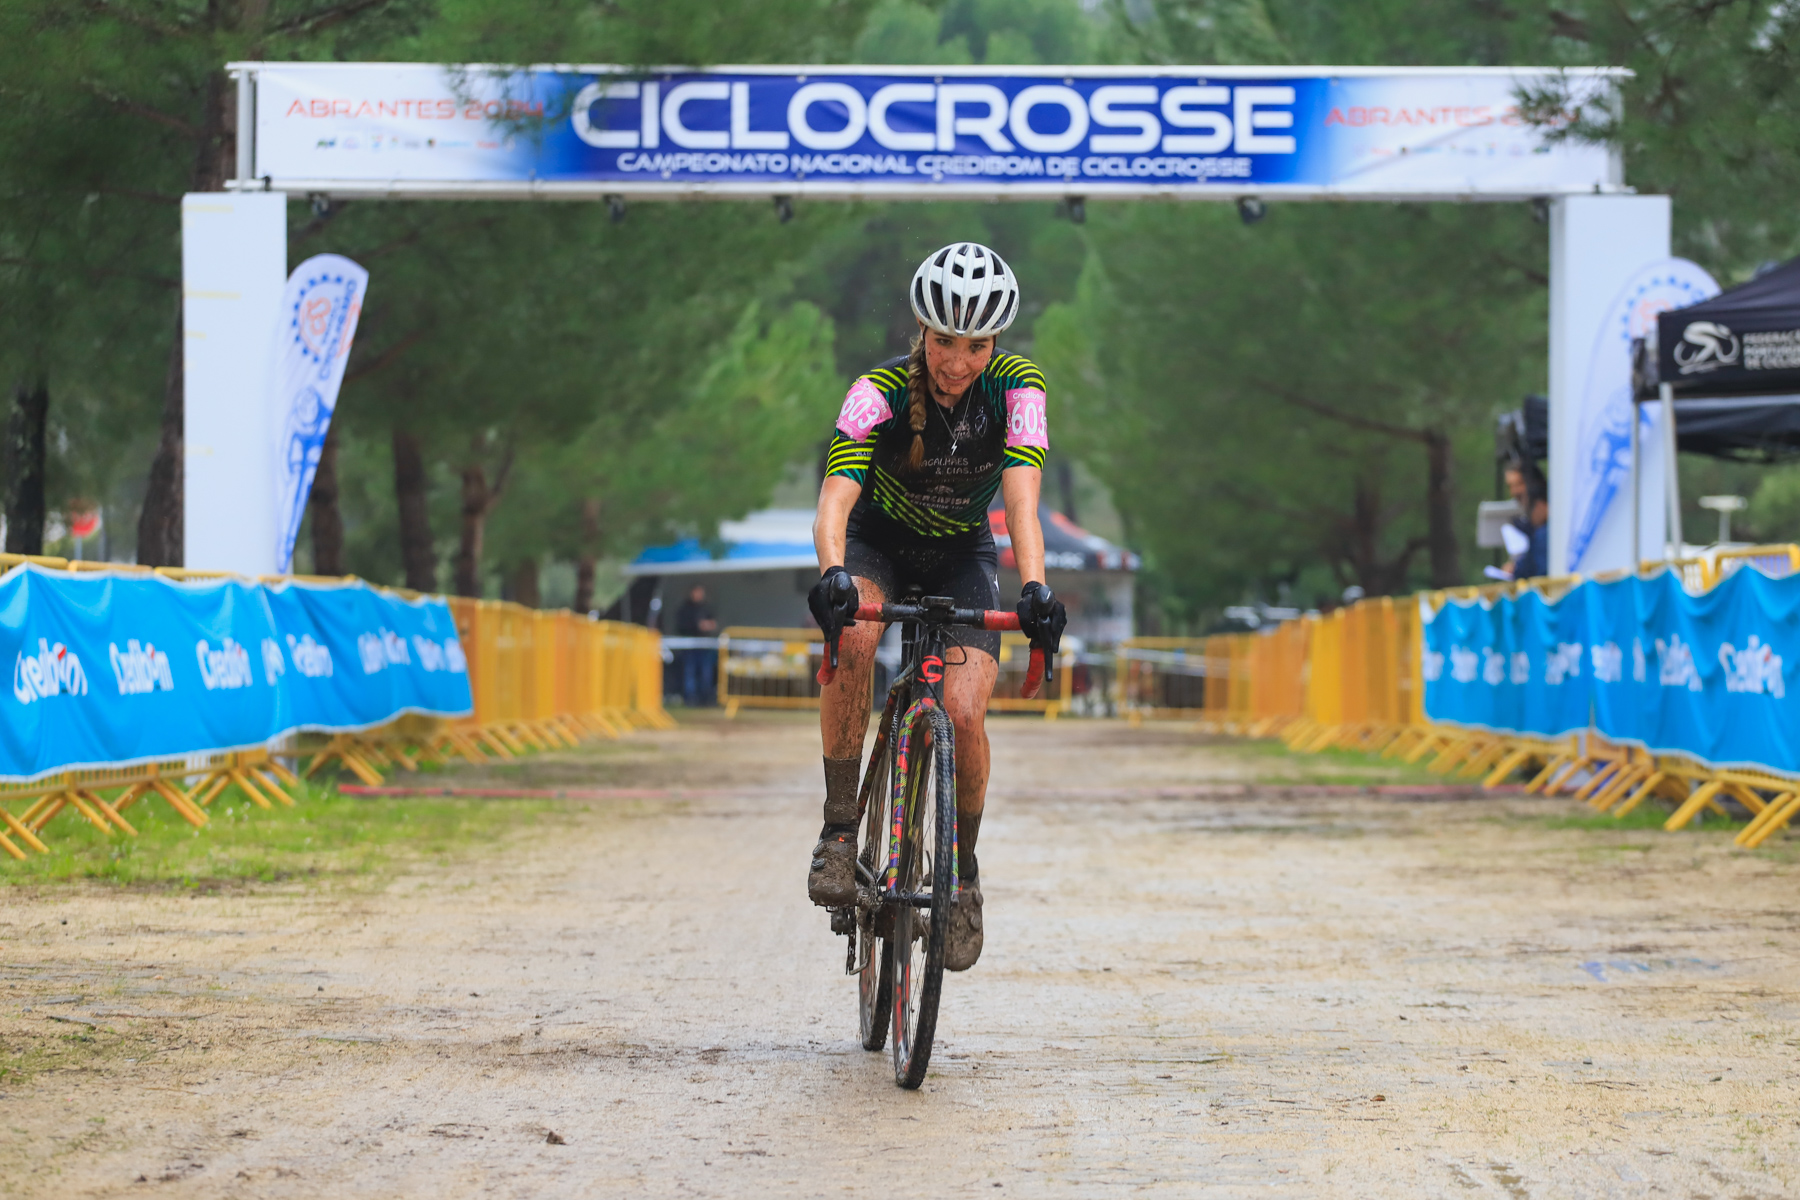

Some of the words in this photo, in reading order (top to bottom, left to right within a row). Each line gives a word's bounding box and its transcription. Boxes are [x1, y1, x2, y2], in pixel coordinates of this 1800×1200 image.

[286, 99, 457, 119] ABRANTES
[571, 81, 1296, 154] CICLOCROSSE
[1324, 106, 1494, 127] ABRANTES
[617, 152, 789, 172] CAMPEONATO
[790, 154, 915, 174] NACIONAL
[916, 155, 1044, 175] CREDIBOM
[1046, 157, 1080, 176] DE
[1082, 157, 1252, 177] CICLOCROSSE
[841, 390, 880, 429] 603
[1011, 401, 1045, 437] 603
